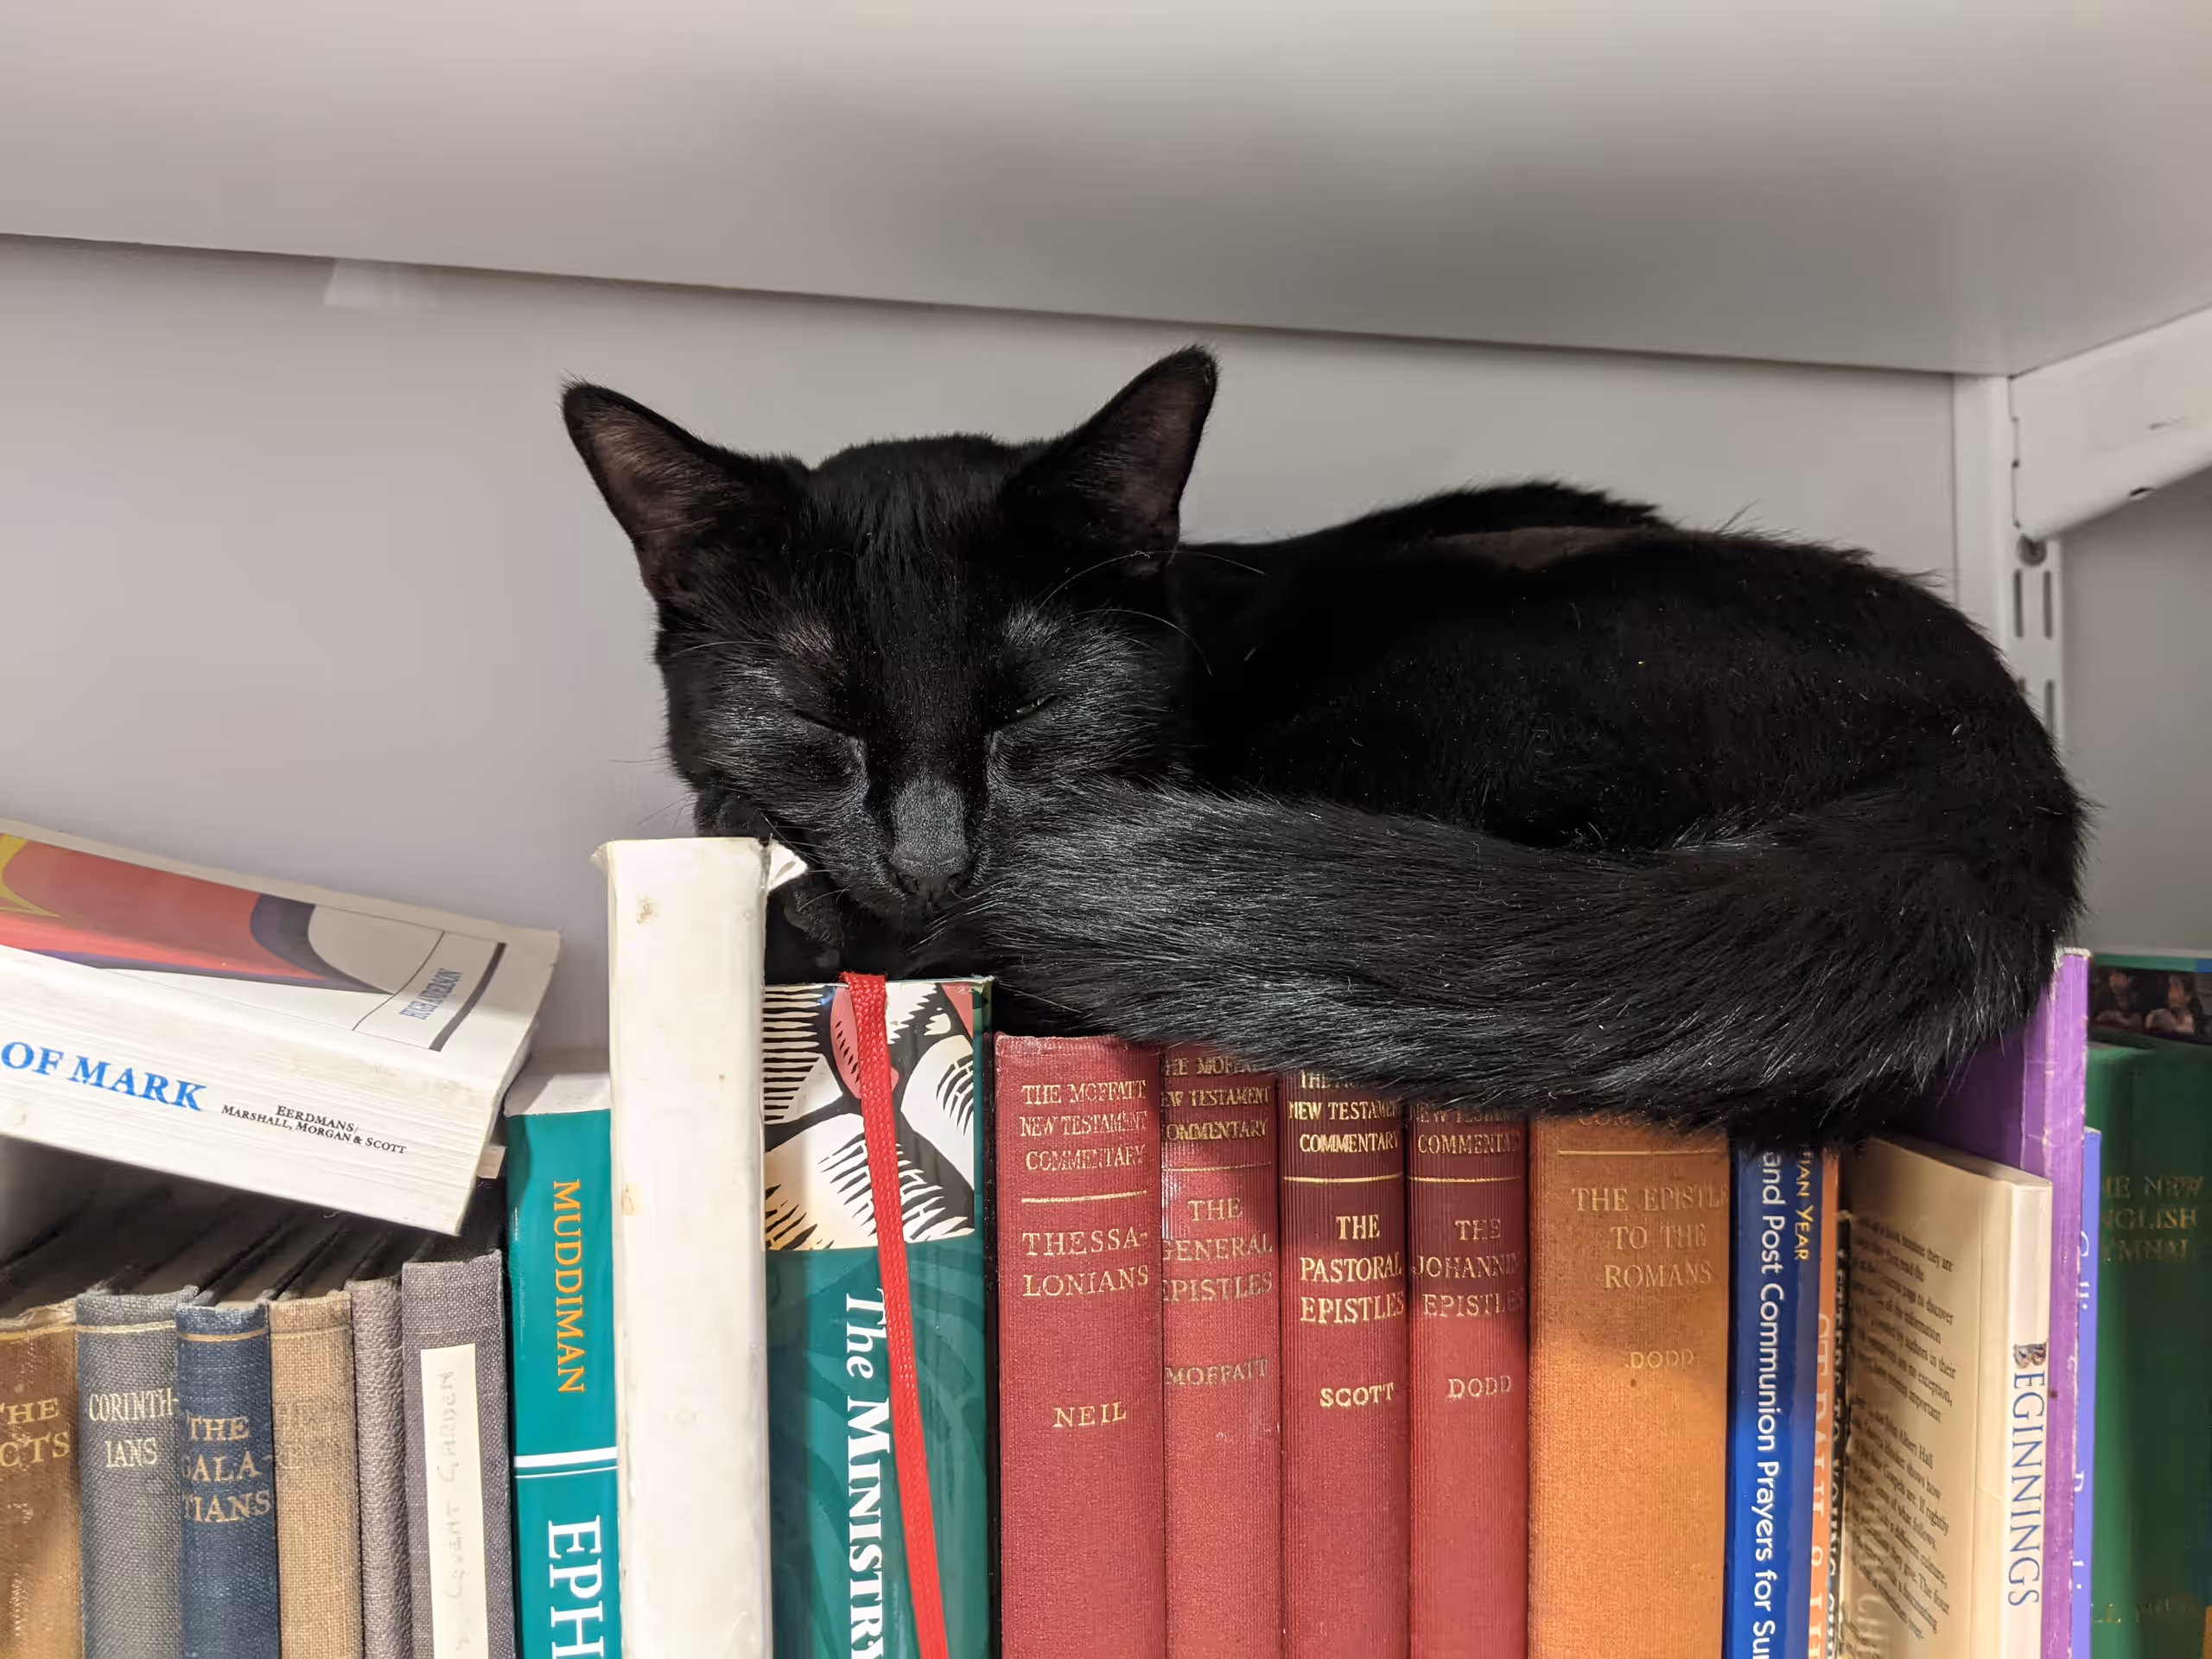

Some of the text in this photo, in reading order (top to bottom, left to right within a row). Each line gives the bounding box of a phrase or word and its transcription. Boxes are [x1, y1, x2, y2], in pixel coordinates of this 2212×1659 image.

[1, 1041, 207, 1112] OF MARK
[1021, 1079, 1146, 1104] THE MOFFATT
[1189, 1086, 1270, 1107] TESTAMENT
[1020, 1110, 1147, 1137] NEW TESTAMENT
[1287, 1101, 1323, 1120] NEW
[221, 1104, 407, 1154] MARSHALL, MORGAN & SCOTT
[1165, 1121, 1268, 1141] OMMENTARY
[1026, 1144, 1146, 1171] COMMENTARY
[1187, 1198, 1243, 1222] THE
[1572, 1187, 1628, 1211] THE
[1021, 1226, 1147, 1255] THESSA-
[1336, 1214, 1380, 1240] THE
[1454, 1218, 1501, 1241] THE
[1610, 1223, 1707, 1250] TO THE
[1795, 1204, 1814, 1261] YEAR
[1022, 1264, 1148, 1297] LONIANS
[1300, 1251, 1402, 1283] PASTORAL
[1605, 1260, 1713, 1288] ROMANS
[553, 1178, 586, 1393] MUDDIMAN
[1300, 1291, 1404, 1324] EPISTLES
[846, 1287, 887, 1379] The
[1630, 1348, 1695, 1370] DODD
[1319, 1382, 1395, 1408] SCOTT
[1447, 1375, 1512, 1401] DODD
[1052, 1401, 1127, 1428] NEIL
[1751, 1152, 1786, 1659] and Post Communion Prayers for Su
[186, 1411, 250, 1441] THE
[105, 1438, 157, 1468] IANS
[2007, 1341, 2047, 1605] BEGINNINGS
